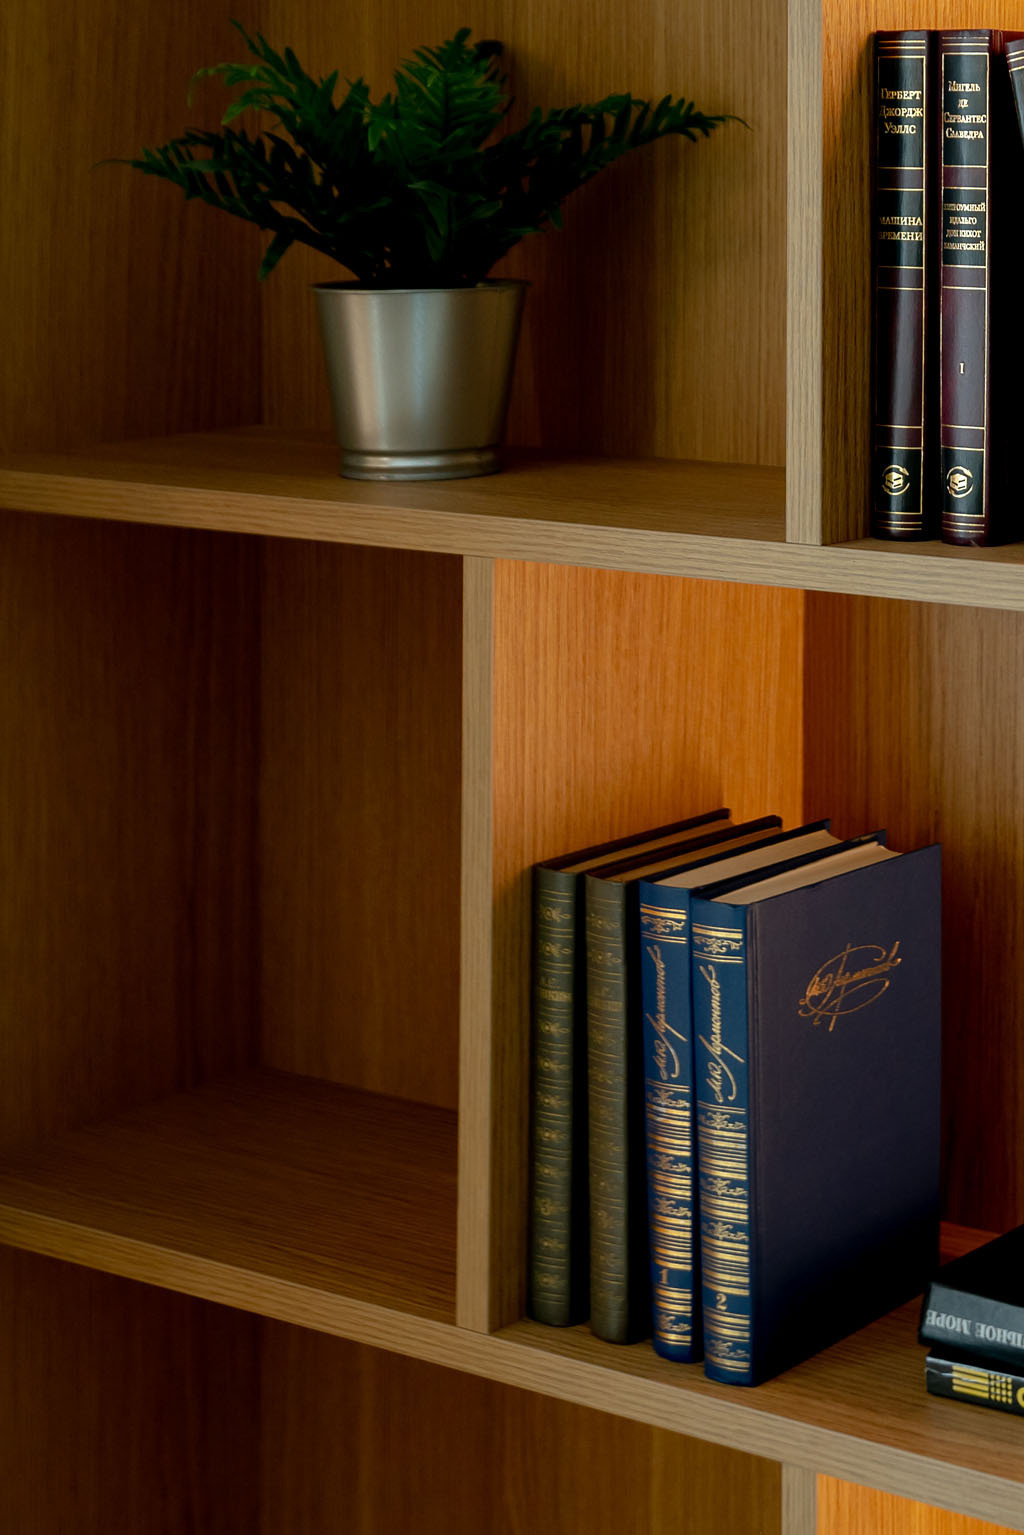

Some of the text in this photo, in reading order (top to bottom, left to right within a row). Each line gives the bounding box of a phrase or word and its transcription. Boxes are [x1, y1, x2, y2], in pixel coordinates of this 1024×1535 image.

[659, 1268, 668, 1284] 1
[715, 1293, 728, 1311] 2
[925, 1309, 972, 1335] МОРЕ
